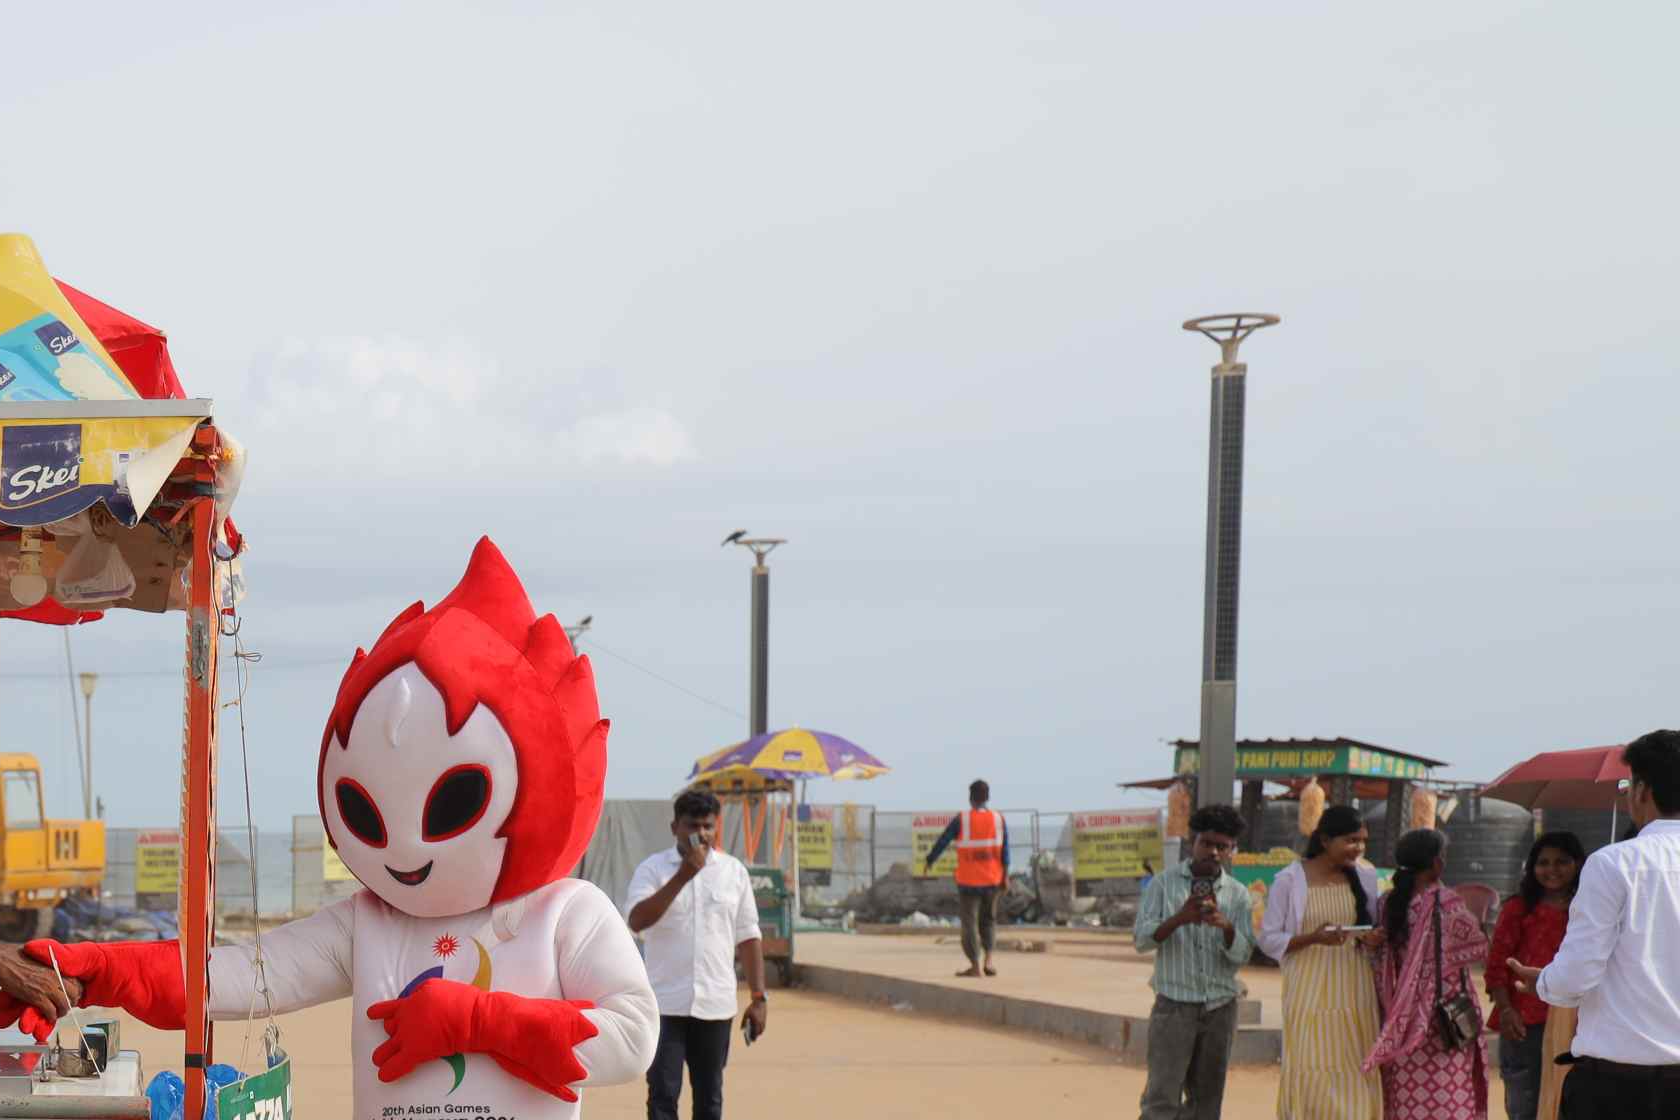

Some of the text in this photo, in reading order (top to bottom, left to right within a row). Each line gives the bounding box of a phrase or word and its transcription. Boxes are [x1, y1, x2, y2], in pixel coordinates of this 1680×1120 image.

[8, 455, 86, 501] Skei
[382, 1104, 491, 1117] 20th Asian Games
